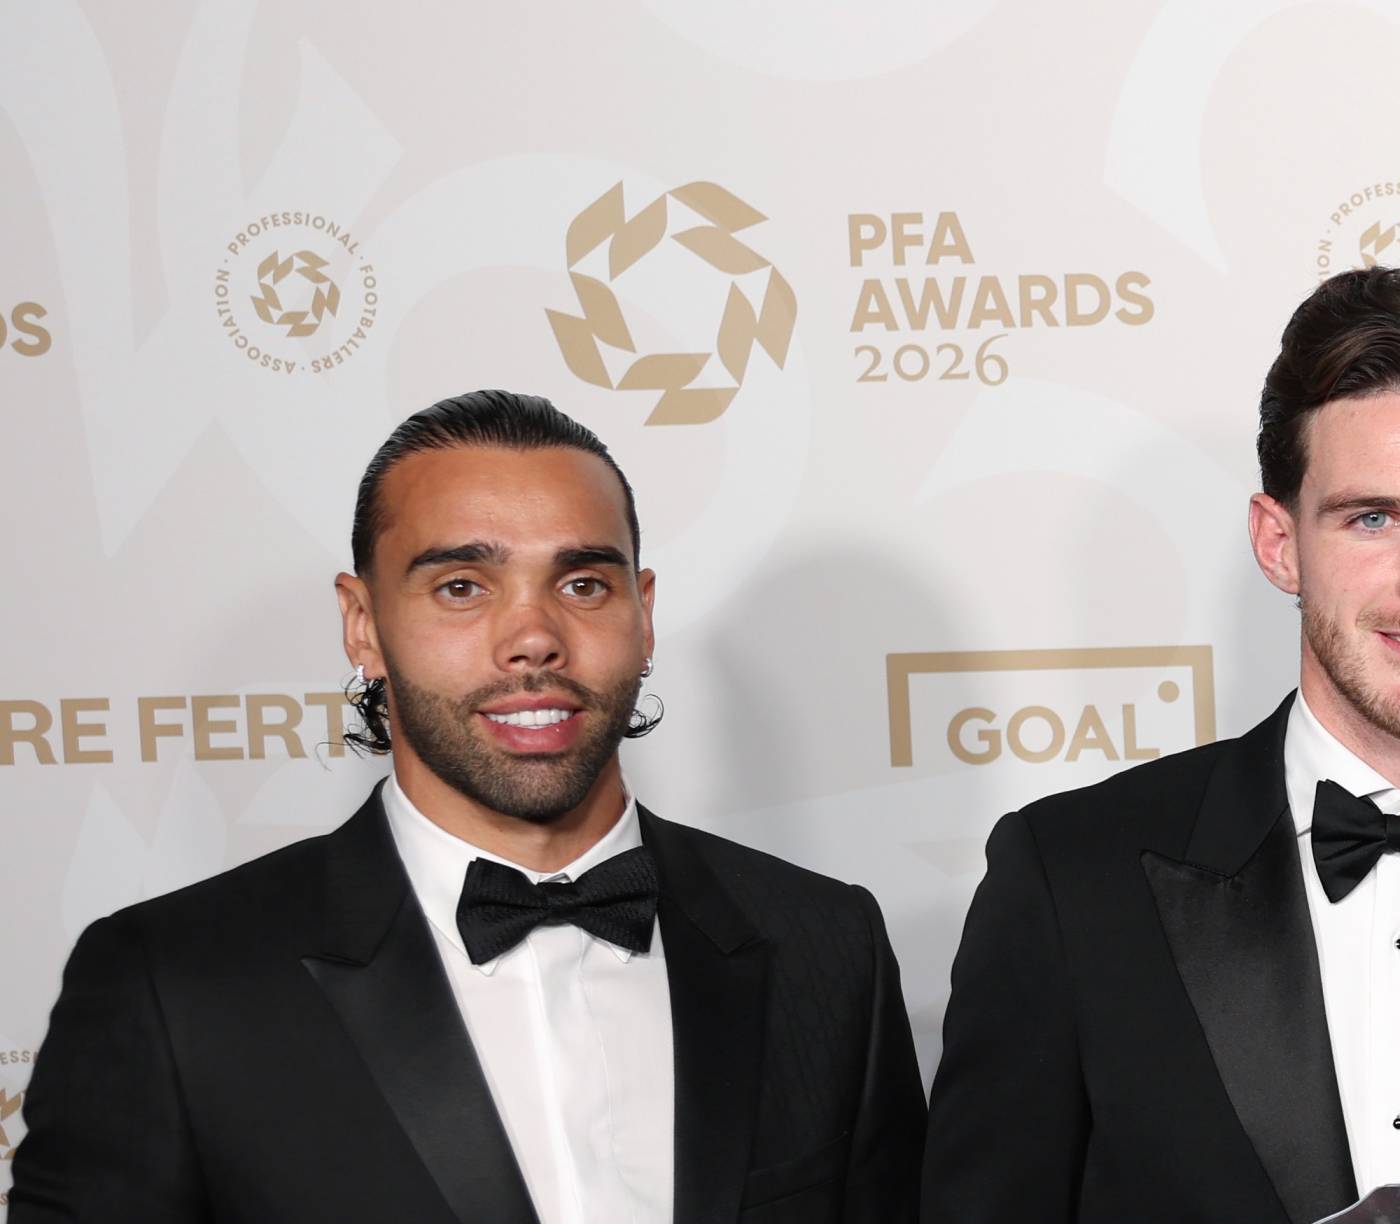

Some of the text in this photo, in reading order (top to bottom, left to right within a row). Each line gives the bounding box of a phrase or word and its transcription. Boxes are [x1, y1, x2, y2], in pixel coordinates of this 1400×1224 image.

[847, 211, 975, 267] PFA
[215, 212, 378, 374] PROFESSIONAL FOOTBALLERS ASSOCIATION
[849, 271, 1156, 333] AWARDS
[854, 333, 1010, 387] 2026
[138, 691, 363, 763] FERT
[947, 704, 1160, 767] GOAL
